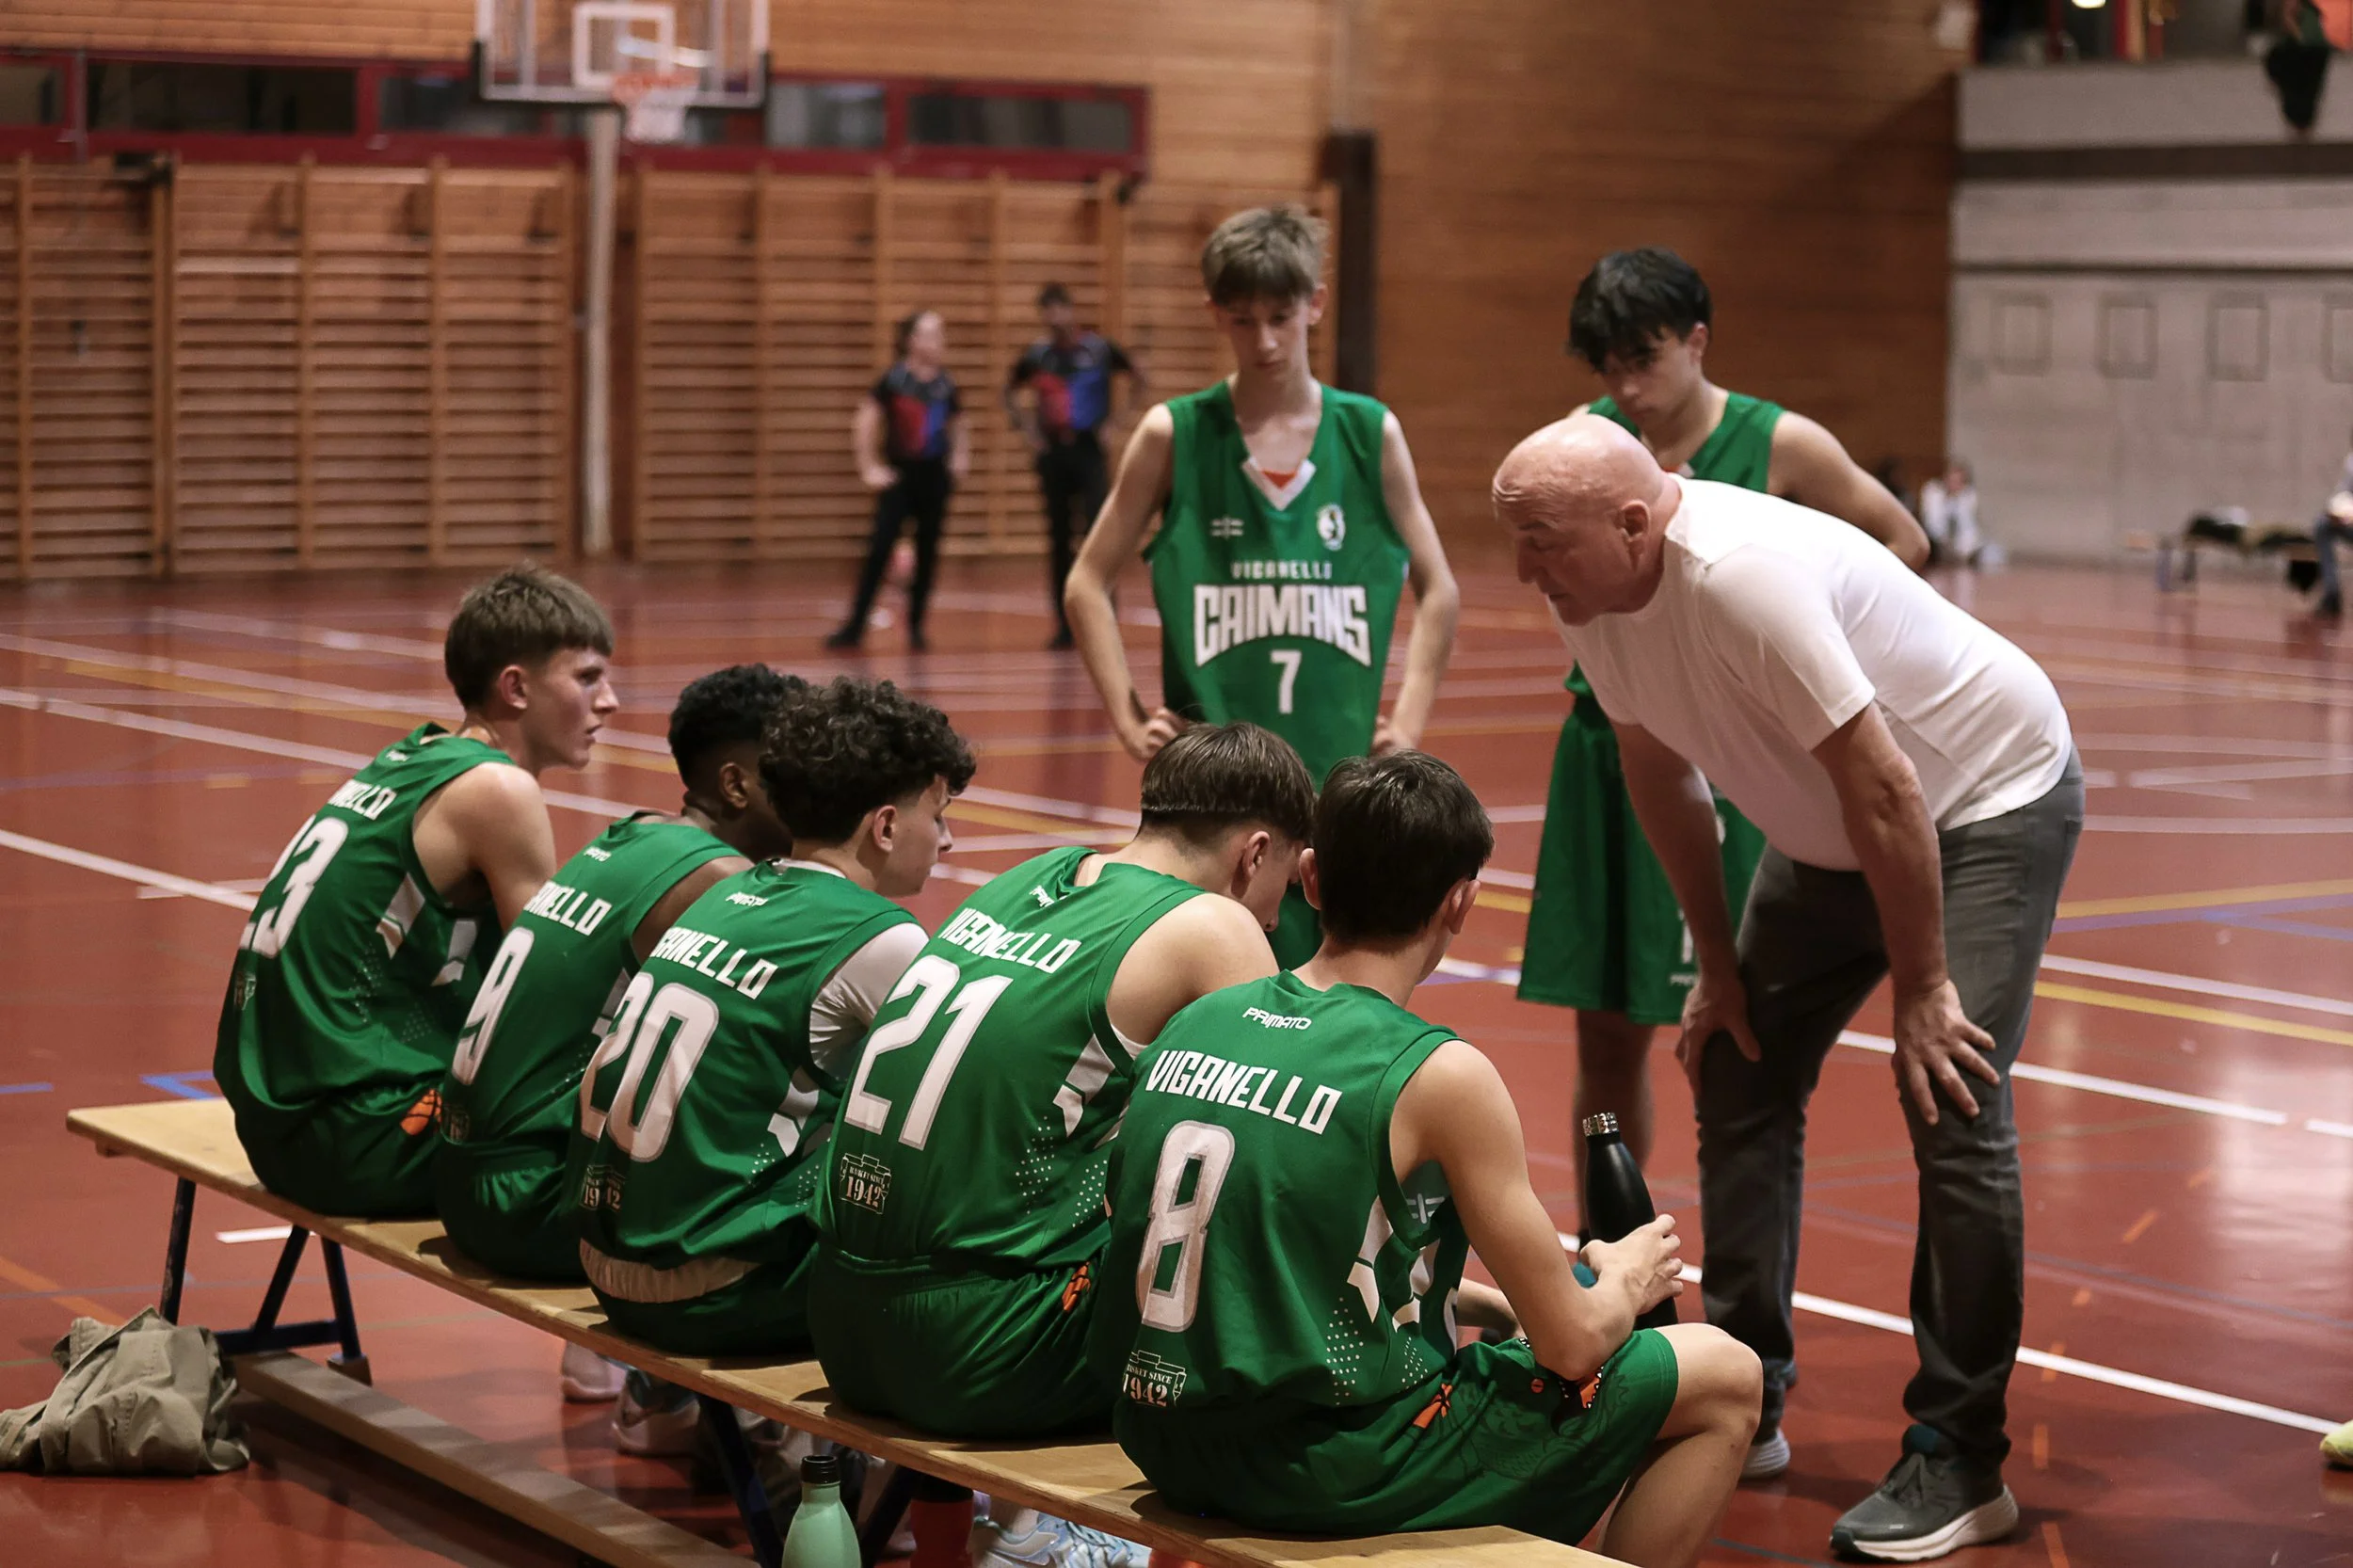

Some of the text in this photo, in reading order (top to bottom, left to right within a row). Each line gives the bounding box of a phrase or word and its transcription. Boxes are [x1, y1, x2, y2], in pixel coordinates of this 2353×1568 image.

[1193, 584, 1372, 667] CAIMANS
[1271, 649, 1302, 714] 7
[452, 926, 535, 1085] 9
[1242, 1006, 1312, 1030] PRIMATO
[580, 972, 720, 1162] 20
[844, 954, 1014, 1151] 21
[1145, 1049, 1343, 1135] VIGANELLO
[846, 1176, 883, 1208] 1942
[1136, 1120, 1236, 1333] 8
[1123, 1373, 1168, 1407] 1942
[1148, 1371, 1173, 1384] SINCE
